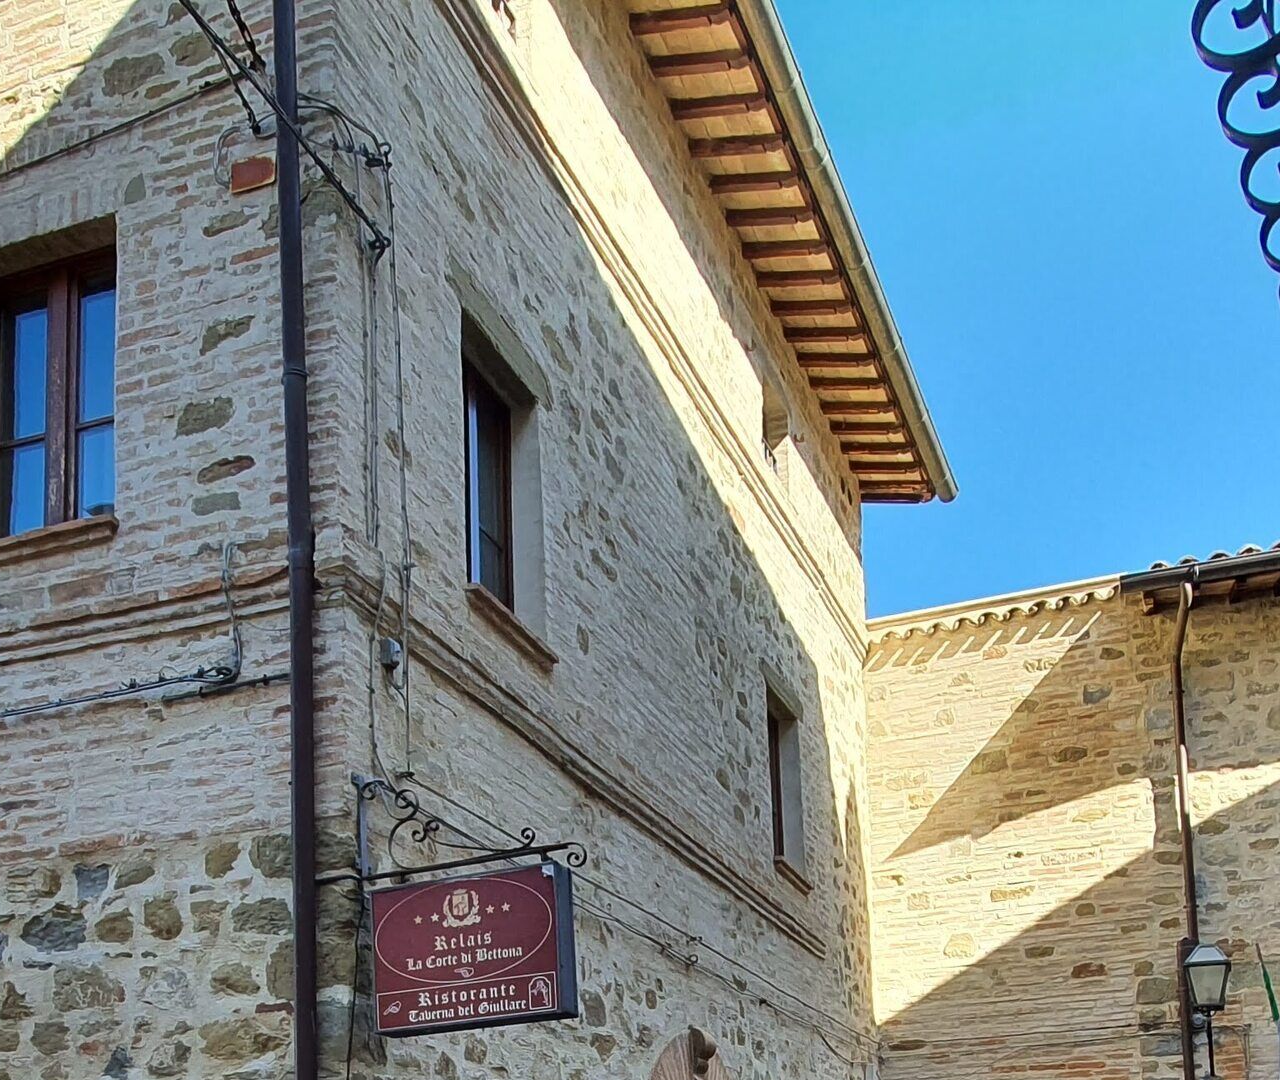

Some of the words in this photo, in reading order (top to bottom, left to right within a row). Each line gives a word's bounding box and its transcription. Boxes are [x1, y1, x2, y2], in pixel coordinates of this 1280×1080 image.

[434, 930, 492, 951] Relais
[406, 958, 422, 971] La
[426, 956, 458, 968] Corte
[461, 951, 472, 963] di
[475, 947, 523, 963] Bettona
[418, 984, 516, 1007] Ristorante
[408, 1008, 455, 1023] Taverna
[458, 1003, 474, 1016] del
[478, 999, 527, 1014] Giullare
